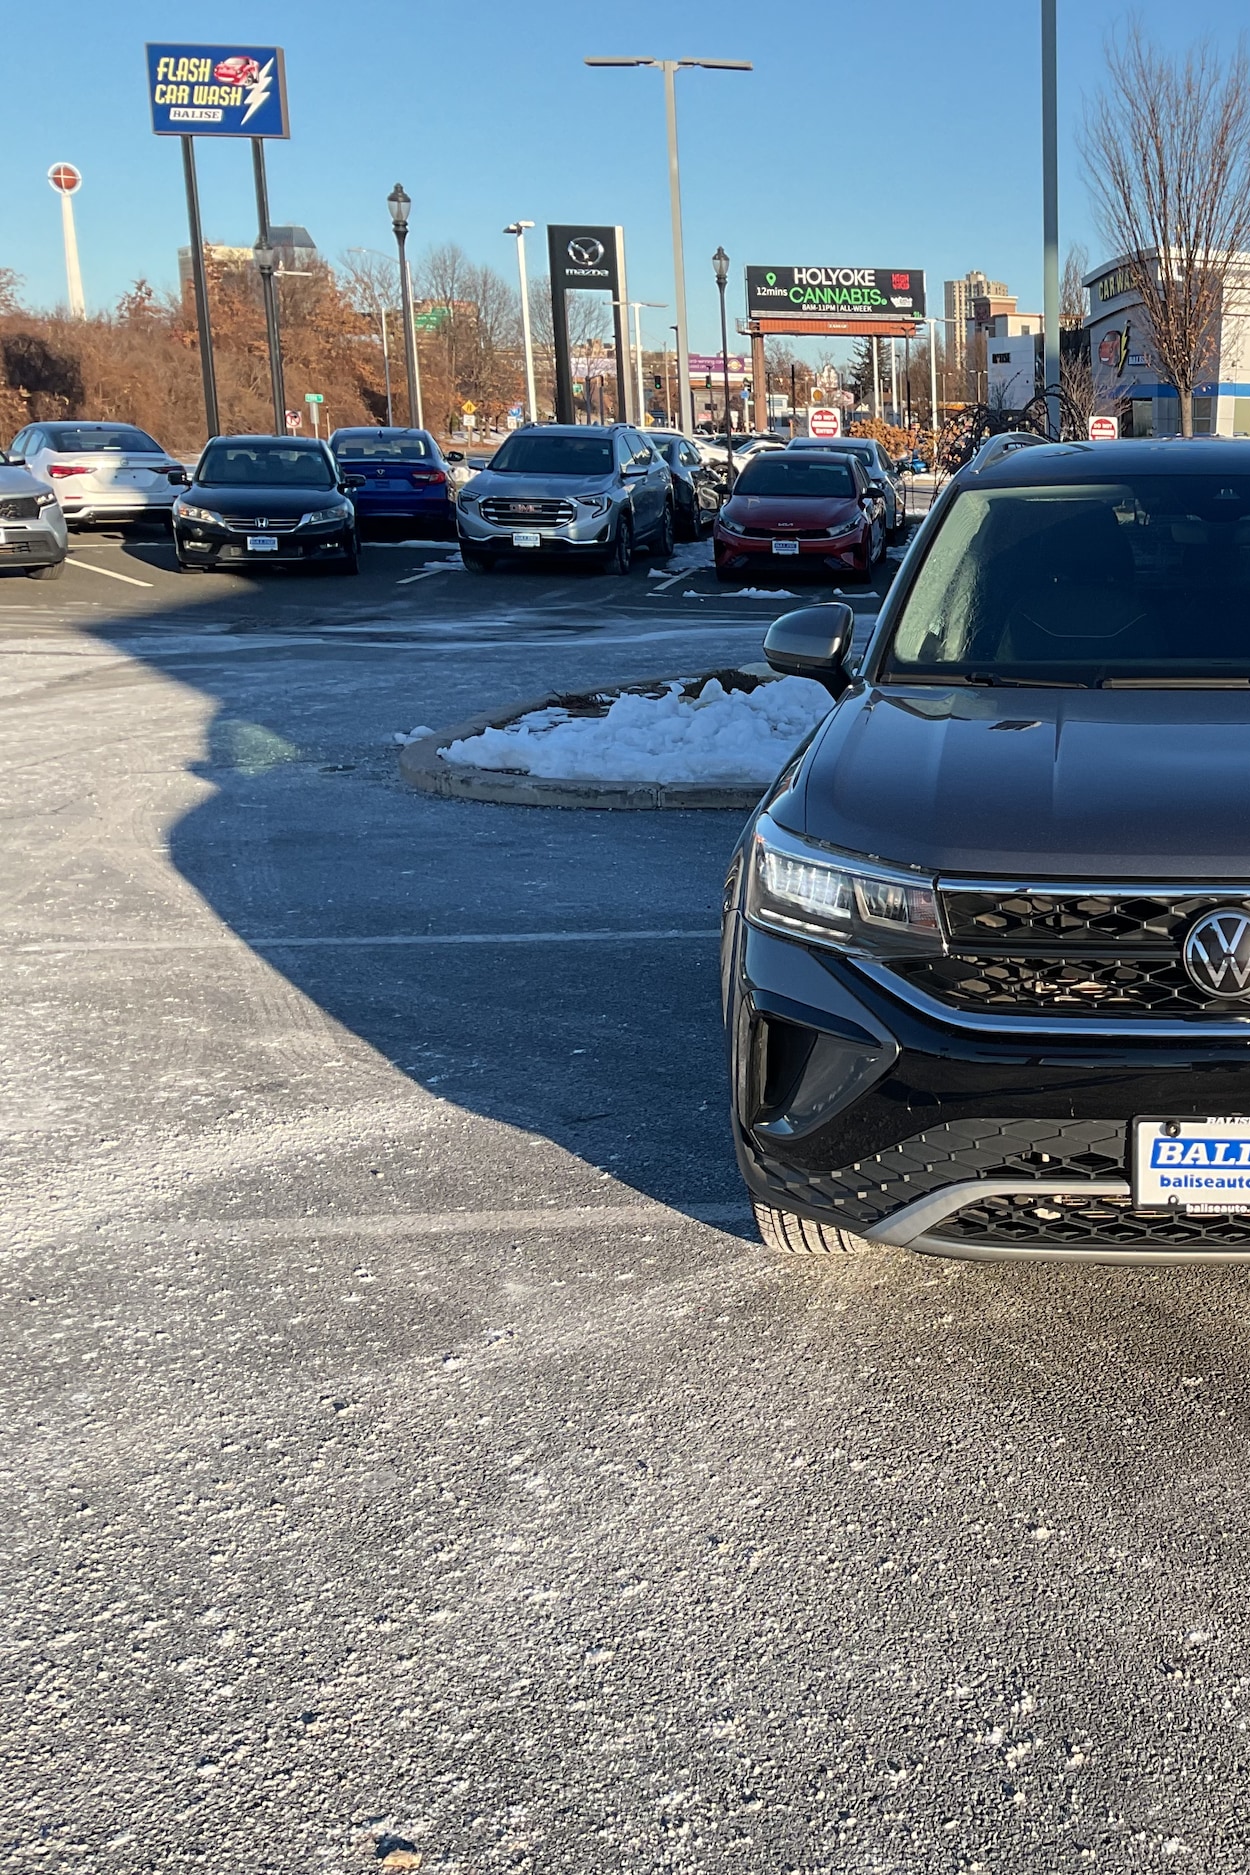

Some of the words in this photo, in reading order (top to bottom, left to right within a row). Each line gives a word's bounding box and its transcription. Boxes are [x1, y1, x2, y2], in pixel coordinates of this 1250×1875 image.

[157, 57, 211, 82] FLASH
[155, 84, 189, 104] CAR
[193, 85, 242, 106] WASH
[173, 109, 220, 119] BALISE
[794, 268, 875, 286] HOLYOKE
[756, 286, 788, 297] 12mins
[1099, 276, 1115, 300] CAR
[802, 304, 836, 312] 8AM-11PM
